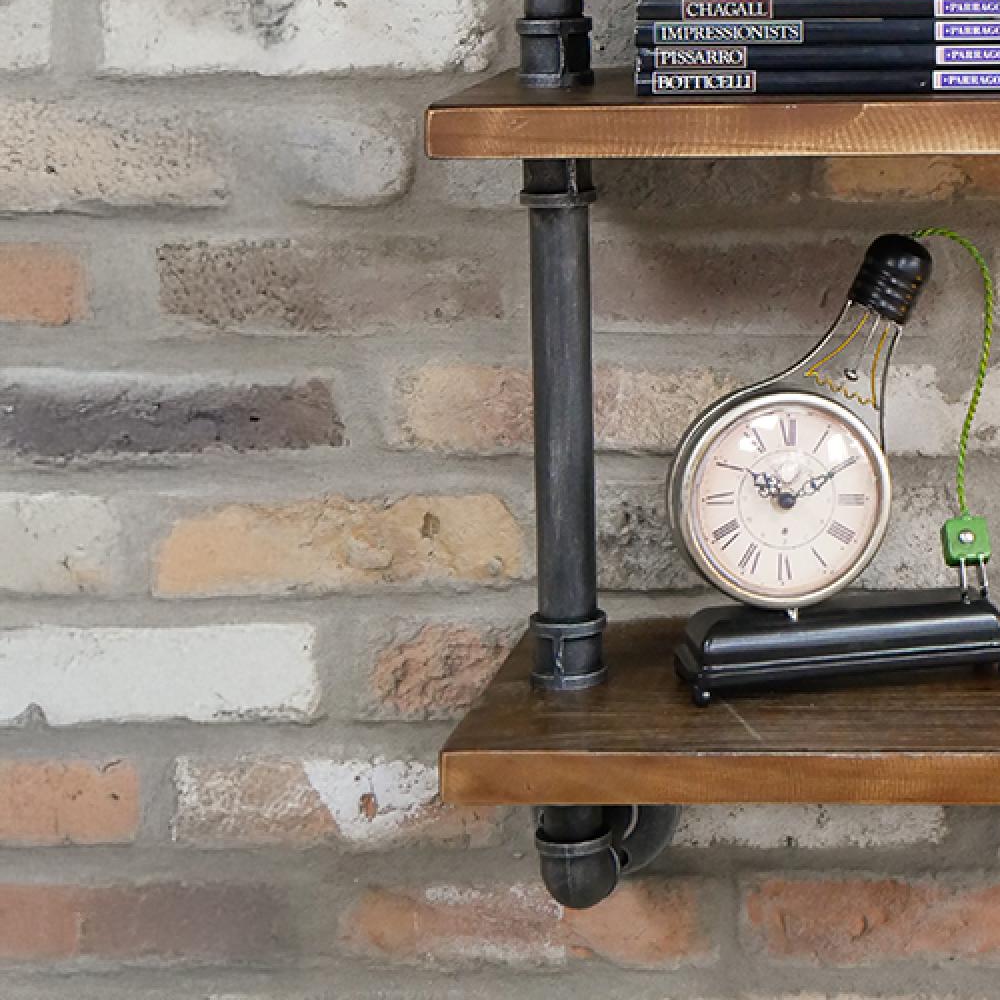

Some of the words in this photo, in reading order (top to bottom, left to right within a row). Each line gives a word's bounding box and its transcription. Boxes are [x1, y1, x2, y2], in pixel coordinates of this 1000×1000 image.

[685, 2, 769, 17] CHAGALL
[660, 25, 800, 41] IMPRESSIONISTS
[660, 51, 743, 65] PISSARRO
[657, 75, 751, 89] BOTTICELLI
